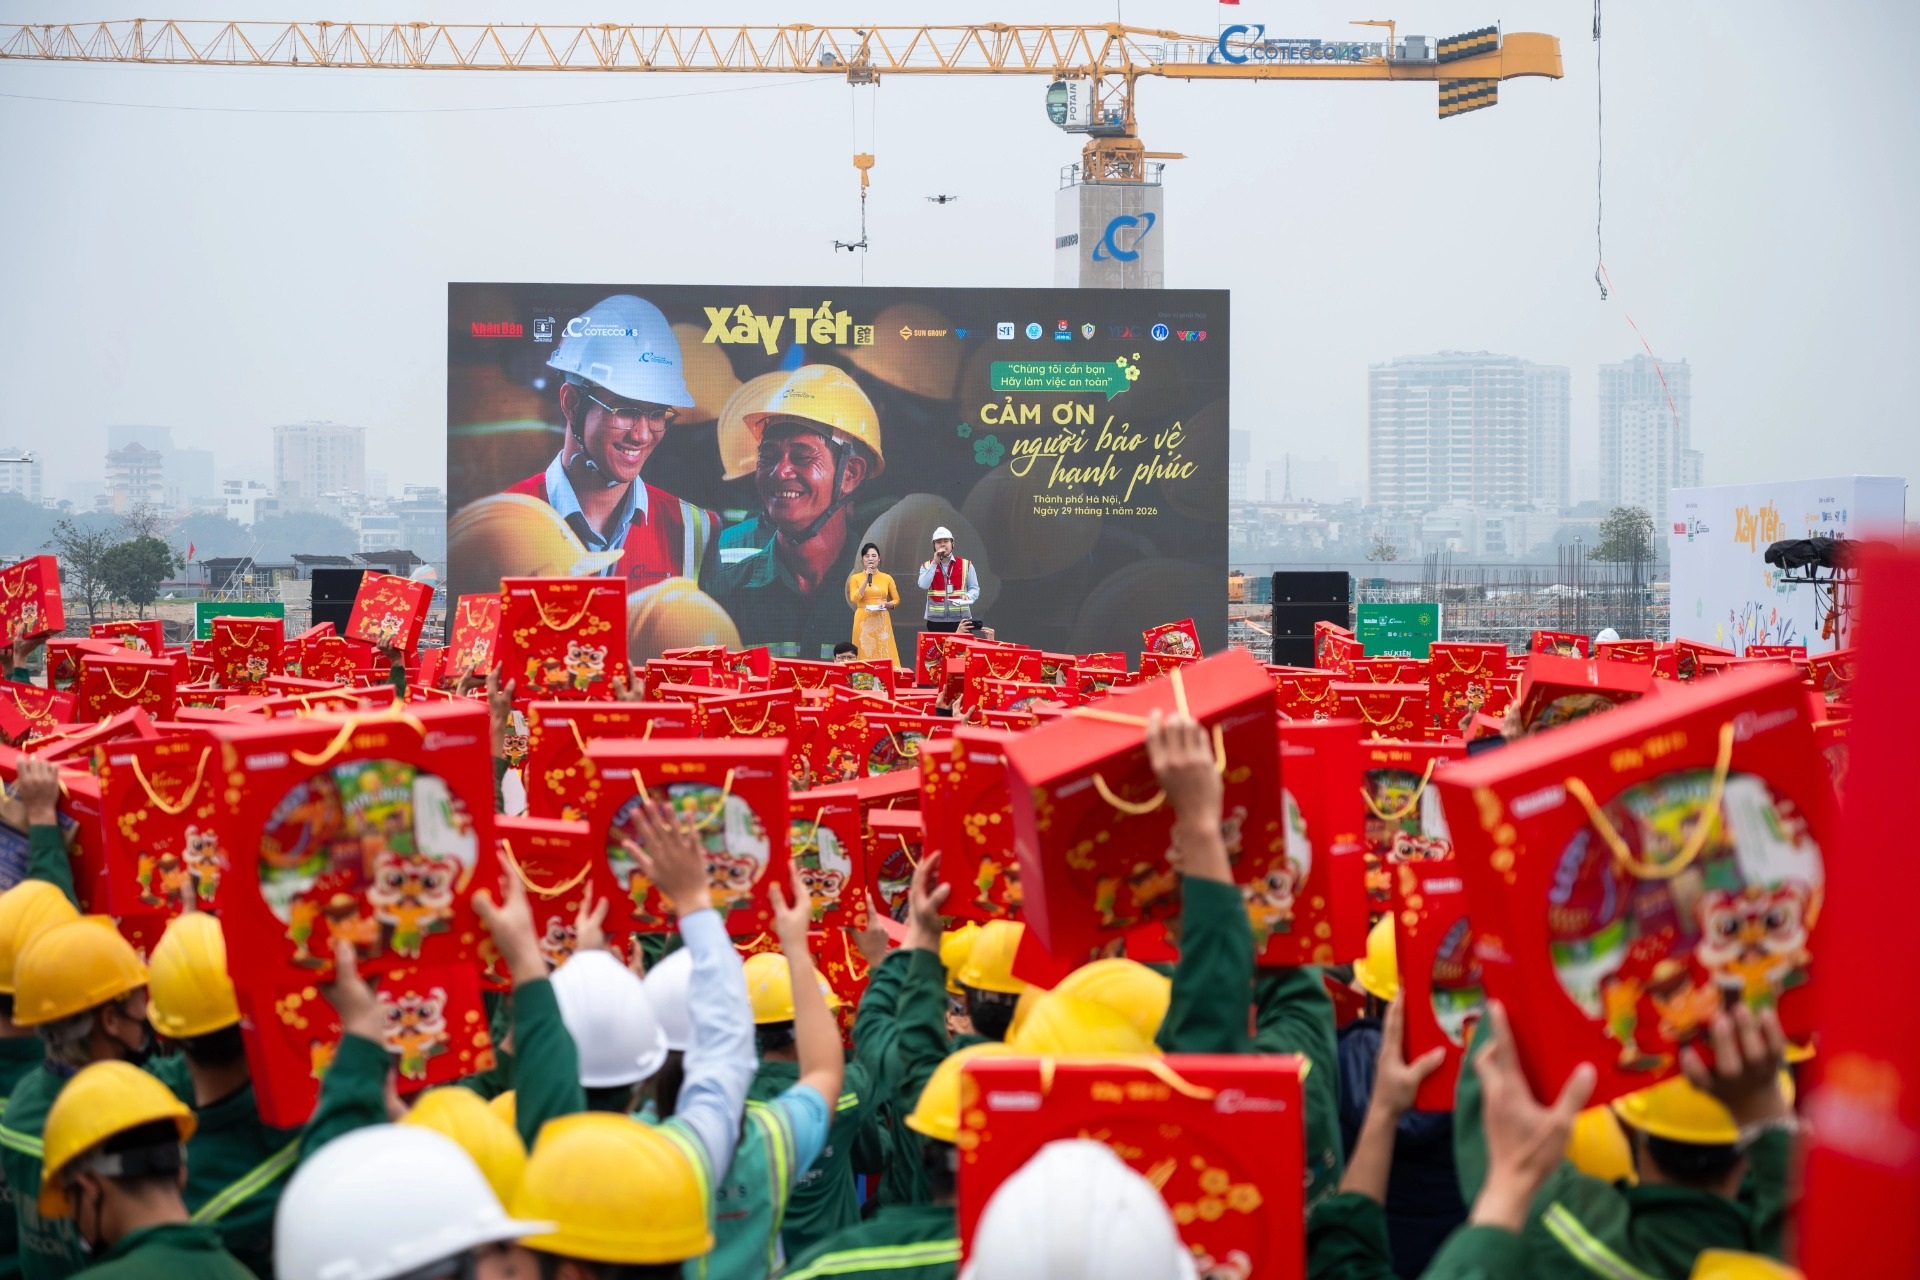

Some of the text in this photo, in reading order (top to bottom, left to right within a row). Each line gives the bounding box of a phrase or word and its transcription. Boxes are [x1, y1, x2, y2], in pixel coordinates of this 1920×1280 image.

[1069, 82, 1077, 121] POTAIN
[702, 300, 852, 356] Xây Tết
[913, 329, 947, 337] SUN GROUP
[1001, 376, 1022, 388] Hãy
[1024, 377, 1043, 386] làm
[1045, 377, 1067, 388] việc
[1048, 364, 1062, 375] tôi
[1064, 362, 1083, 375] cần
[1085, 364, 1105, 377] bạn
[980, 396, 1095, 425] CẢM ƠN
[1010, 414, 1187, 478] người bảo vệ
[1047, 452, 1199, 503] hạnh phúc
[1033, 493, 1121, 506] Thành phố Hà Nội,
[1033, 505, 1060, 517] Ngày
[1061, 506, 1073, 515] 29
[1074, 505, 1103, 517] tháng
[1112, 506, 1134, 516] năm
[1135, 506, 1158, 516] 2026
[1734, 499, 1779, 552] Xây Tết
